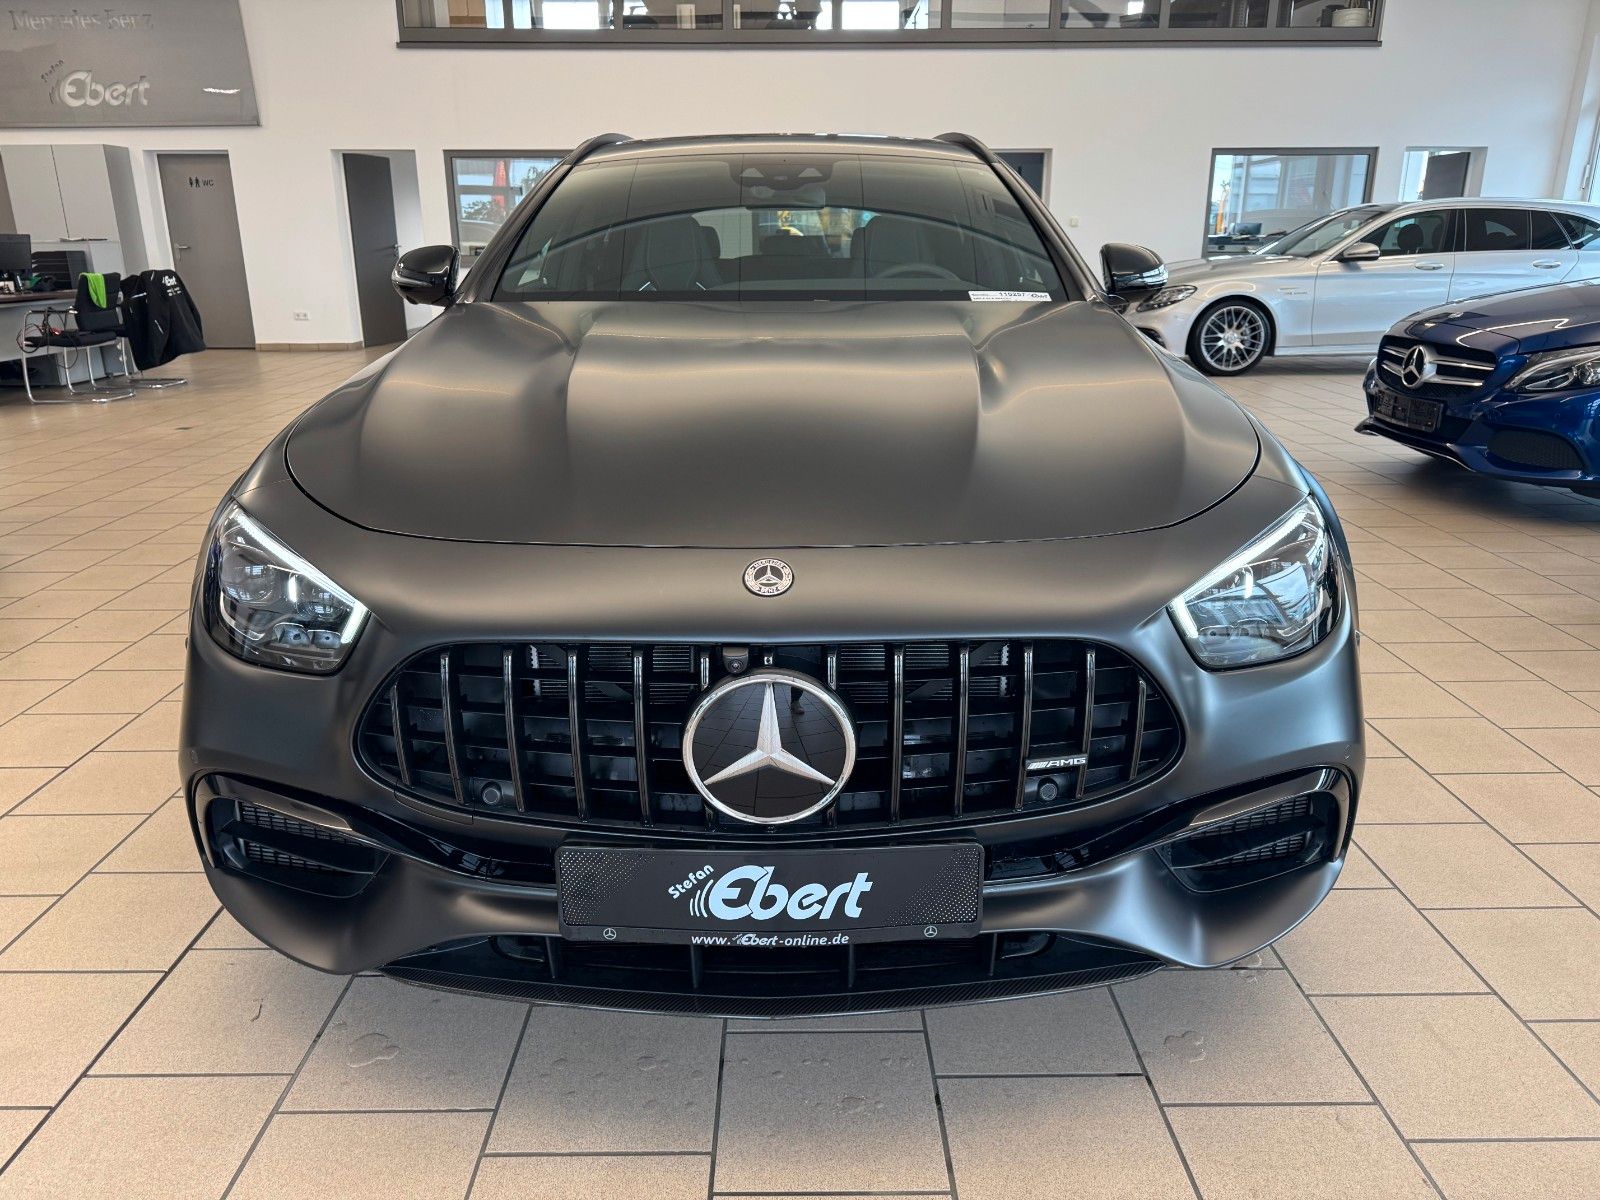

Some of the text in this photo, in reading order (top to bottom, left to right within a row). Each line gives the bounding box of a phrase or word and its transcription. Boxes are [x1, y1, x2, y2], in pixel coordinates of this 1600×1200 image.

[59, 70, 150, 107] Ebert
[201, 176, 215, 187] WC
[1046, 757, 1086, 768] AMG
[668, 864, 715, 899] Stefan
[708, 865, 874, 921] Ebert
